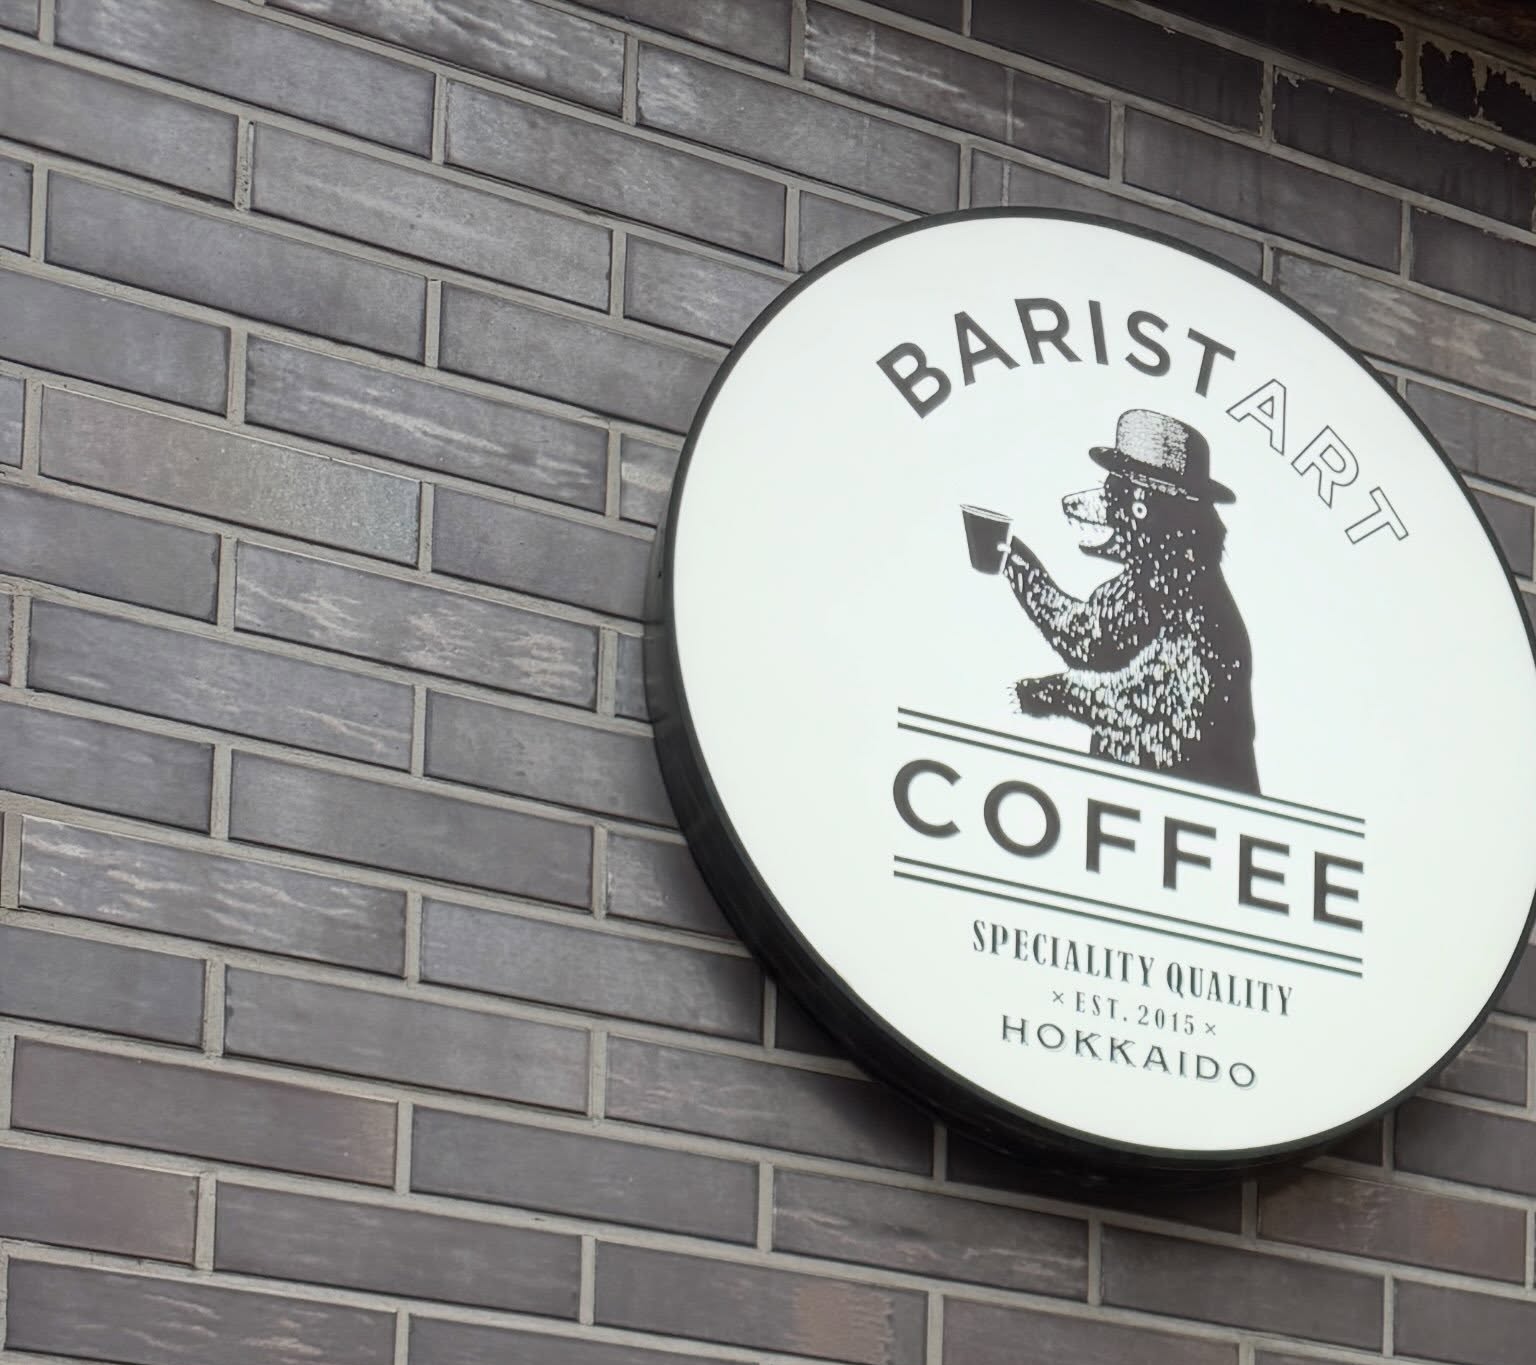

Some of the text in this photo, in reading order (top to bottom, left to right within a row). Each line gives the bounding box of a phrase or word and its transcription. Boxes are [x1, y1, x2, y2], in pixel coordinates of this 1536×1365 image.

[876, 297, 1409, 544] BARISTART
[892, 758, 1365, 933] COFFEE
[972, 919, 1293, 1016] SPECIALITY QUALITY
[1075, 991, 1195, 1036] EST. 2015
[1001, 1014, 1258, 1089] HOKKAIDO
